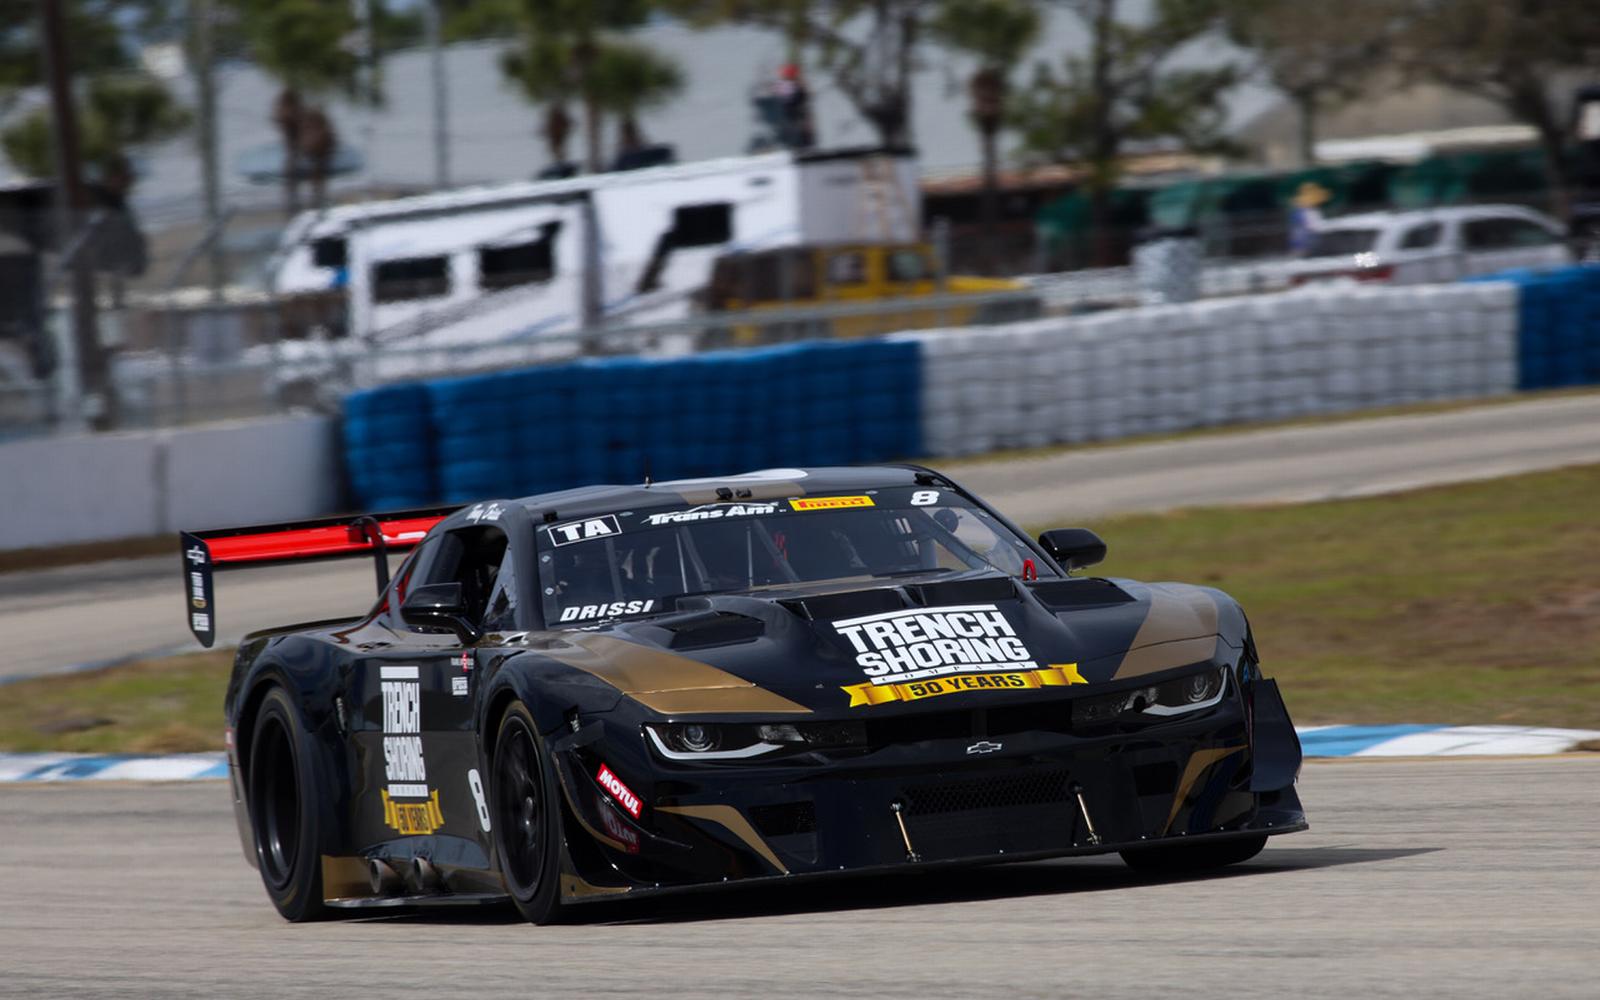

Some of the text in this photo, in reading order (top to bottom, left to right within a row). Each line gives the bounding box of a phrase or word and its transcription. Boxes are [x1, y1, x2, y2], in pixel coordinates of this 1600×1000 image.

[649, 505, 775, 525] Trans Am
[910, 491, 940, 506] 8
[557, 519, 612, 541] TA
[560, 600, 654, 622] DRISSI
[836, 611, 1017, 653] TRENCH
[856, 637, 1031, 676] SHORING
[911, 674, 1026, 697] 50 YEARS
[381, 682, 421, 733] TRENCH
[383, 736, 426, 781] SHORING
[468, 769, 491, 832] 8
[599, 769, 639, 815] MOTUL
